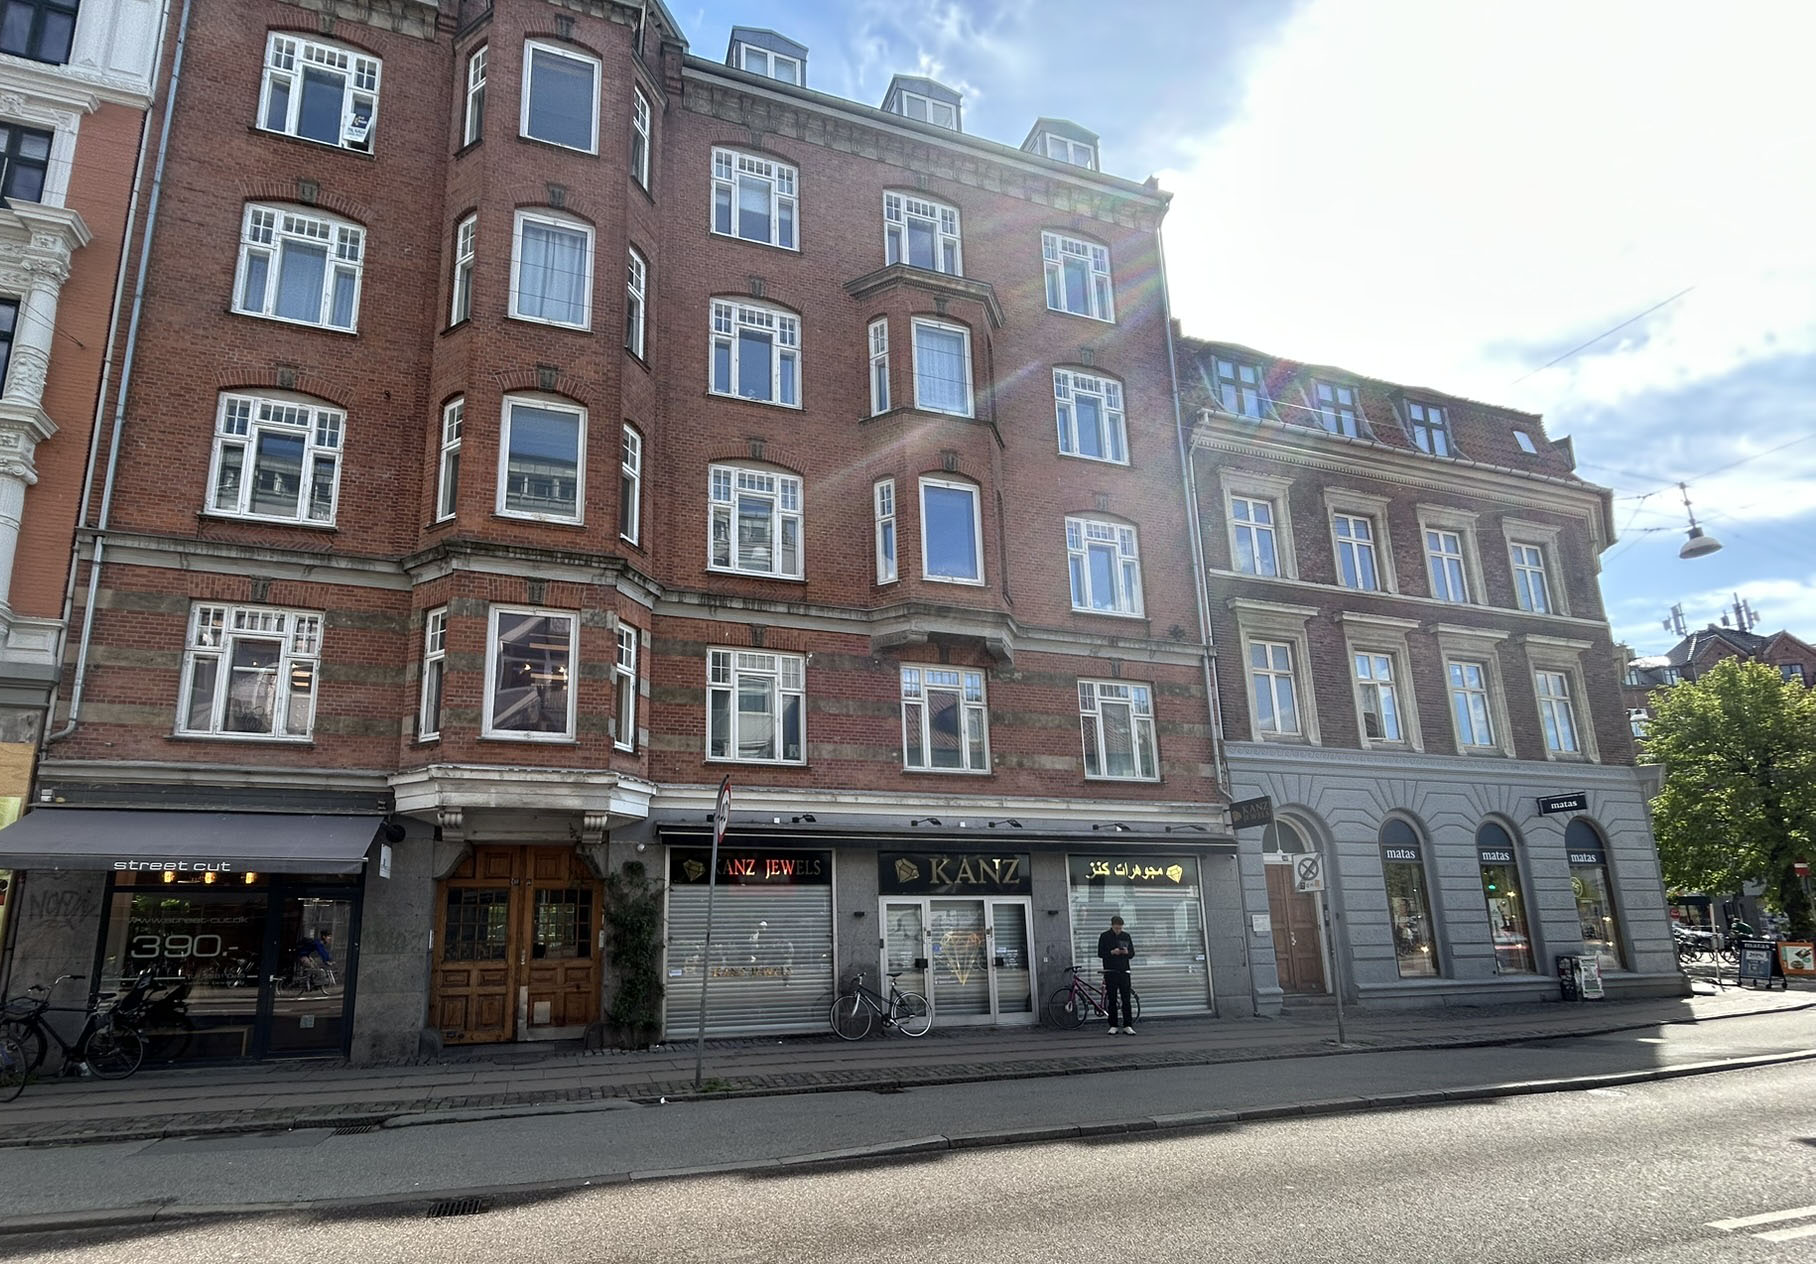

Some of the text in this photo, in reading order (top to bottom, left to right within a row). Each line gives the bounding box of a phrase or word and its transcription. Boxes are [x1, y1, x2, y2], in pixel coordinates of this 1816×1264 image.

[1551, 799, 1578, 810] matas
[1386, 849, 1416, 860] matas
[1481, 850, 1511, 862] matas
[1570, 852, 1597, 863] matas
[113, 860, 231, 872] street cut
[764, 858, 821, 879] JEWELS
[928, 857, 1021, 885] KANZ
[1085, 861, 1164, 880] مجوهرات كنز
